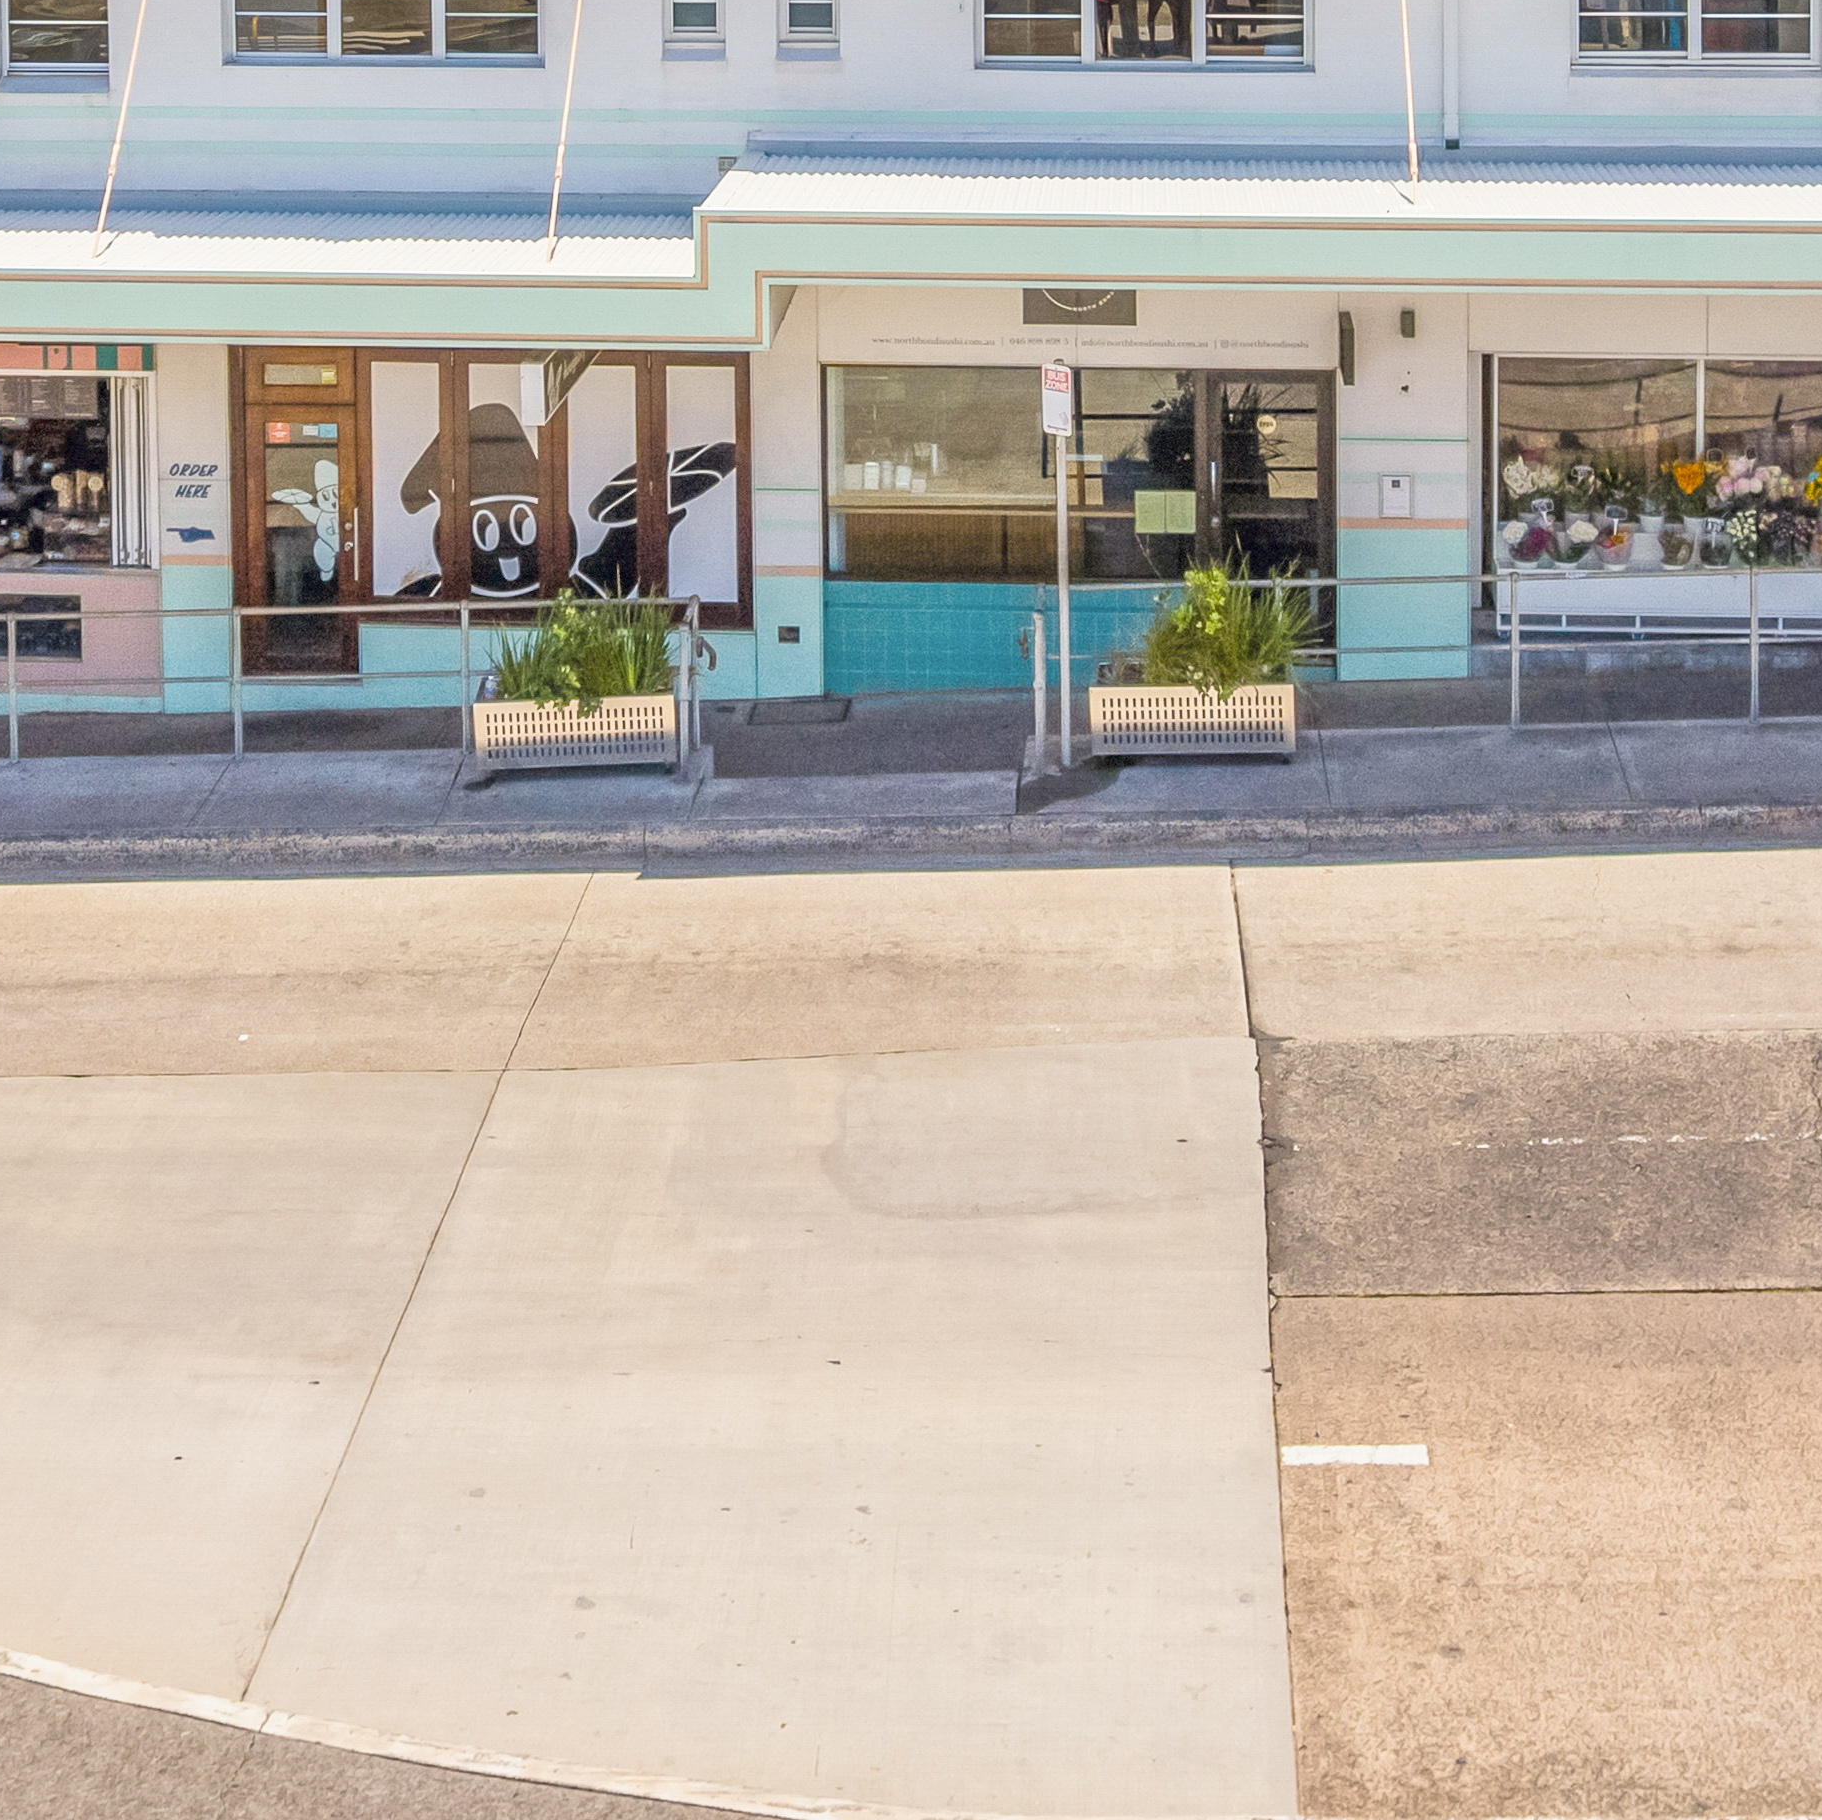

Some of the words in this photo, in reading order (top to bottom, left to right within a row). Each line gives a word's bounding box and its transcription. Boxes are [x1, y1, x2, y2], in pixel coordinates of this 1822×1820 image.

[1046, 370, 1067, 382] BUS
[1045, 380, 1069, 392] ZONE
[169, 463, 218, 477] ORDER
[174, 484, 212, 498] HERE
